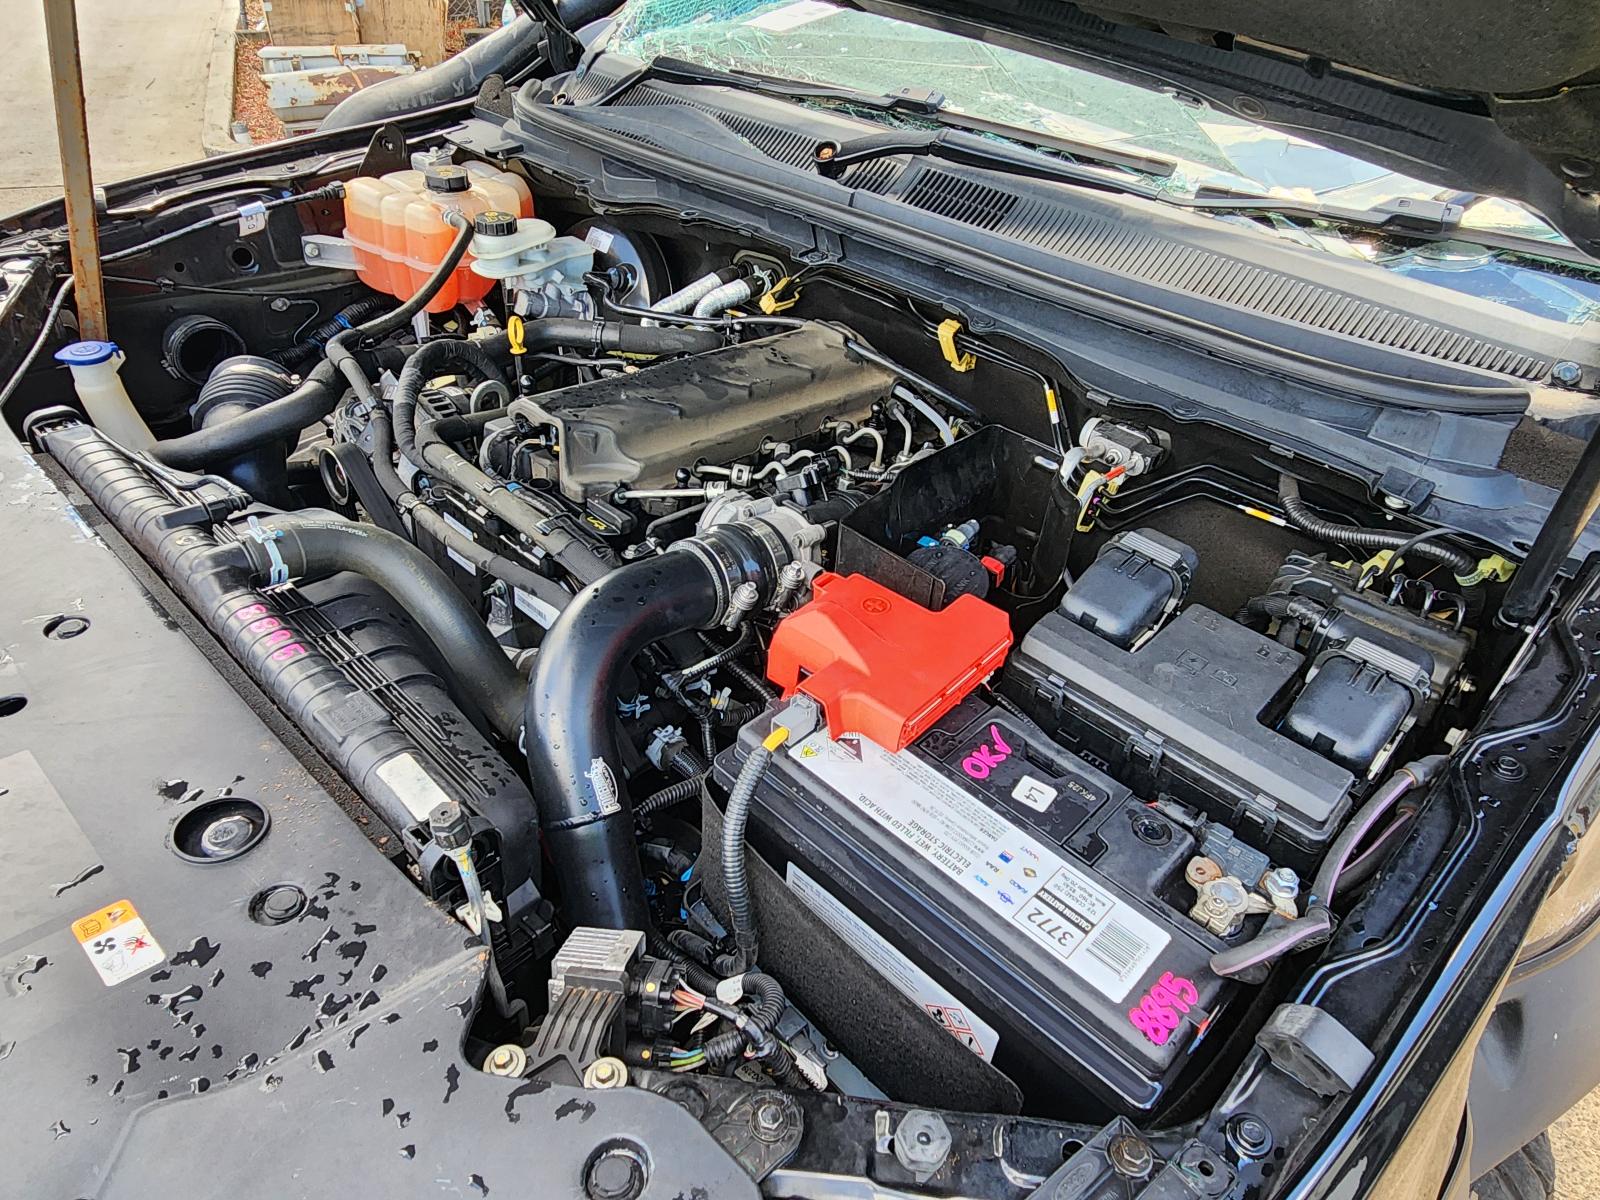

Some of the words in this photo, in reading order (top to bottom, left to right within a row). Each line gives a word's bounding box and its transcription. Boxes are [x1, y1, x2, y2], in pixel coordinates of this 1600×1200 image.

[236, 604, 306, 661] 8895
[962, 745, 1007, 779] OK
[857, 792, 876, 809] ACID,
[1023, 786, 1045, 804] L4
[1067, 782, 1097, 801] 4FKJ25
[874, 806, 892, 822] WITH
[891, 819, 915, 838] FILLED
[908, 819, 938, 844] STORAGE
[913, 835, 931, 850] WET,
[930, 847, 964, 875] BATTERY,
[937, 841, 970, 868] ELECTRIC
[985, 860, 999, 872] RAA
[1038, 889, 1064, 911] BATTERY
[1026, 906, 1074, 947] 3772
[1063, 908, 1091, 931] CALCIUM
[1129, 971, 1198, 1046] 8895
